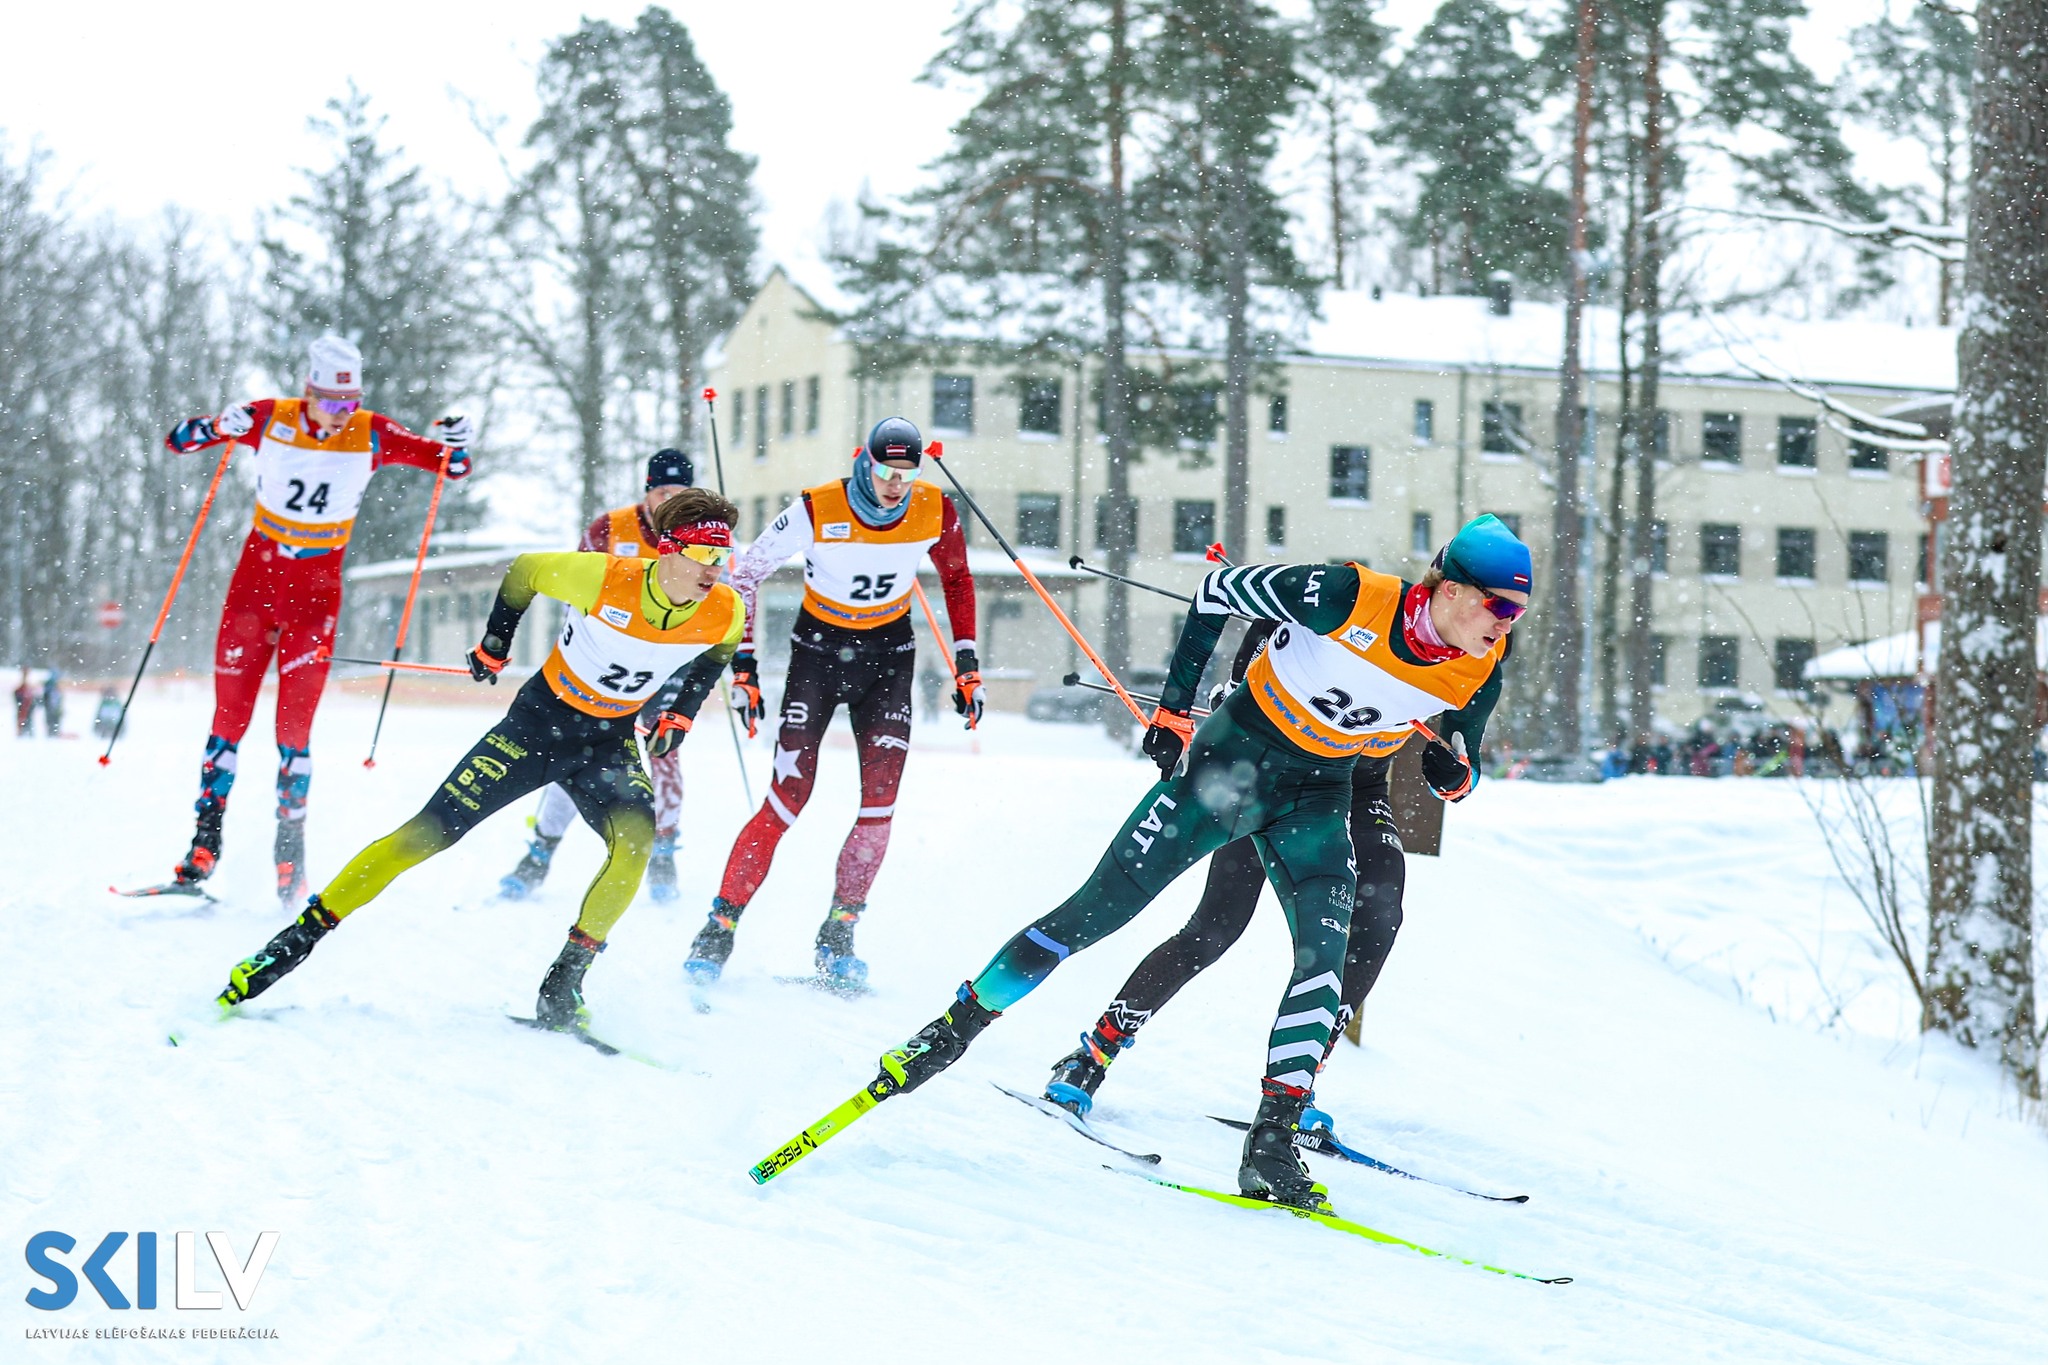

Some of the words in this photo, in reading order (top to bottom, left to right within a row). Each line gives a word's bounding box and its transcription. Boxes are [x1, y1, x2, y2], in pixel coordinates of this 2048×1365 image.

[285, 478, 331, 515] 24
[849, 572, 898, 601] 25
[1303, 569, 1326, 608] LAT
[598, 662, 654, 694] 23
[1308, 686, 1382, 731] 29
[1131, 793, 1177, 855] LAT
[1292, 1132, 1323, 1150] OMON
[757, 1141, 803, 1180] FISCHER
